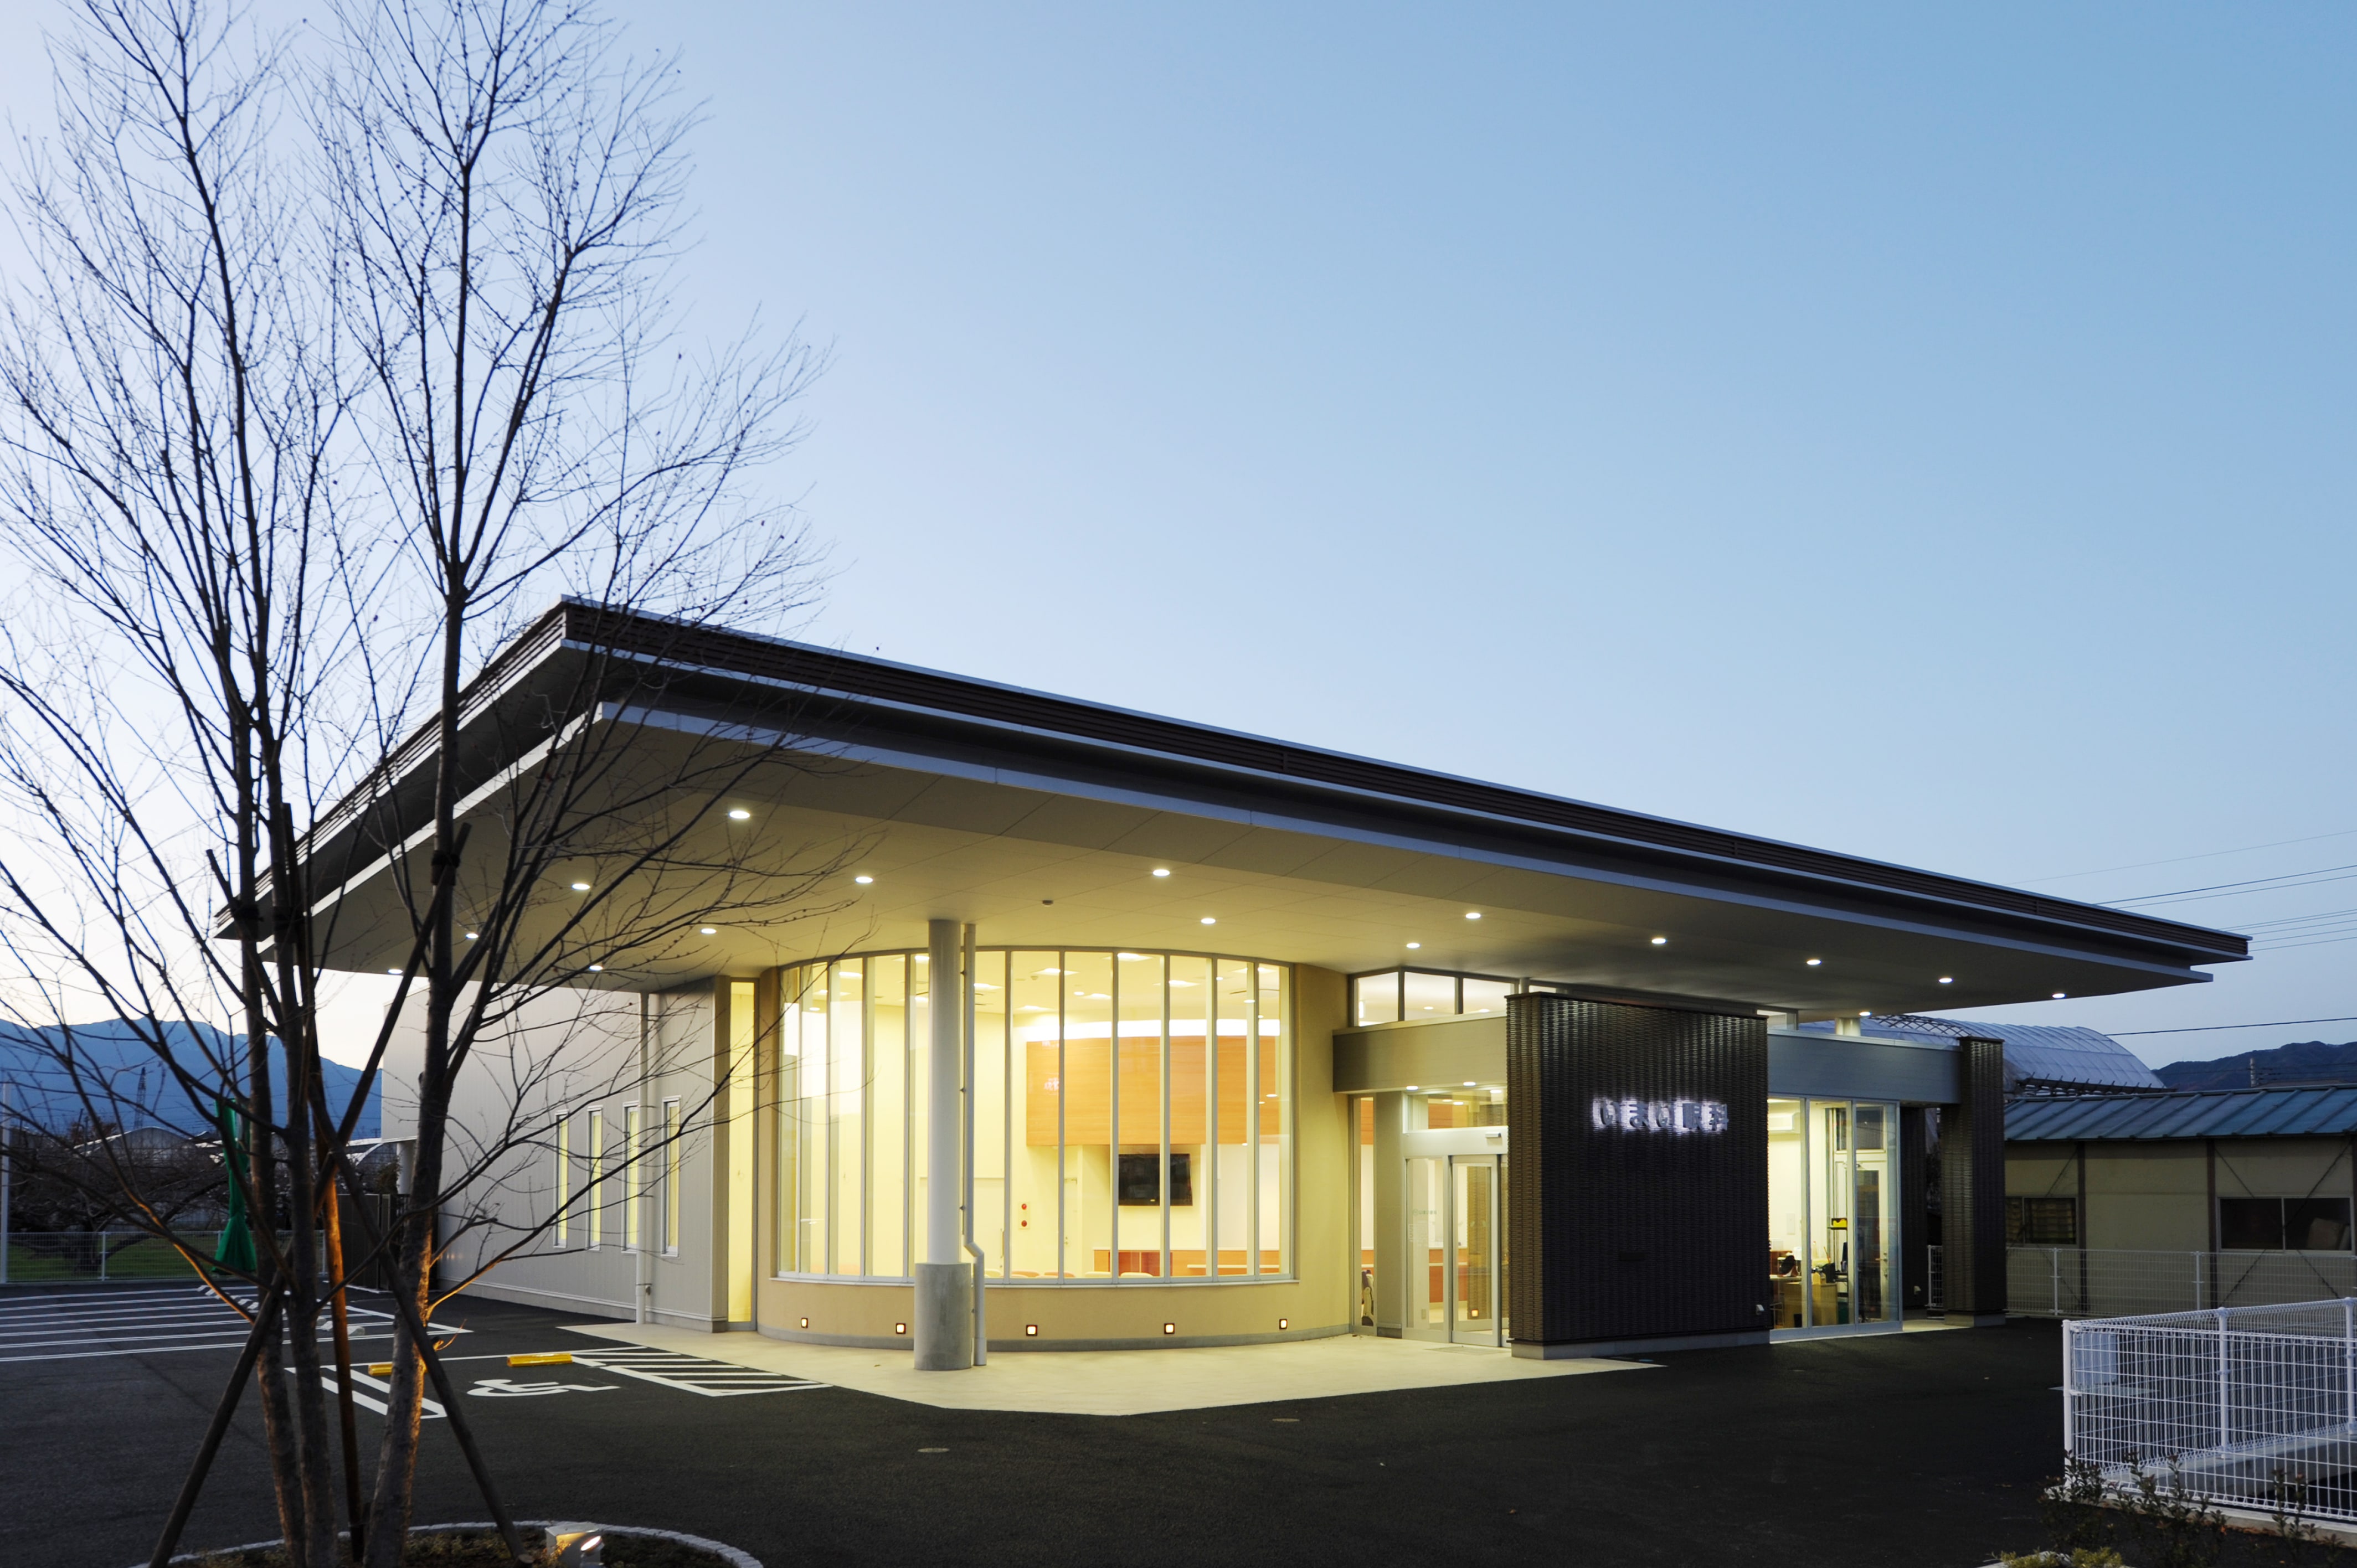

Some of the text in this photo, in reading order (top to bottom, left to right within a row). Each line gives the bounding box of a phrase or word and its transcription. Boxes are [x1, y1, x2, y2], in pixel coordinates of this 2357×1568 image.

[1599, 1101, 1729, 1131] いまい眼科
